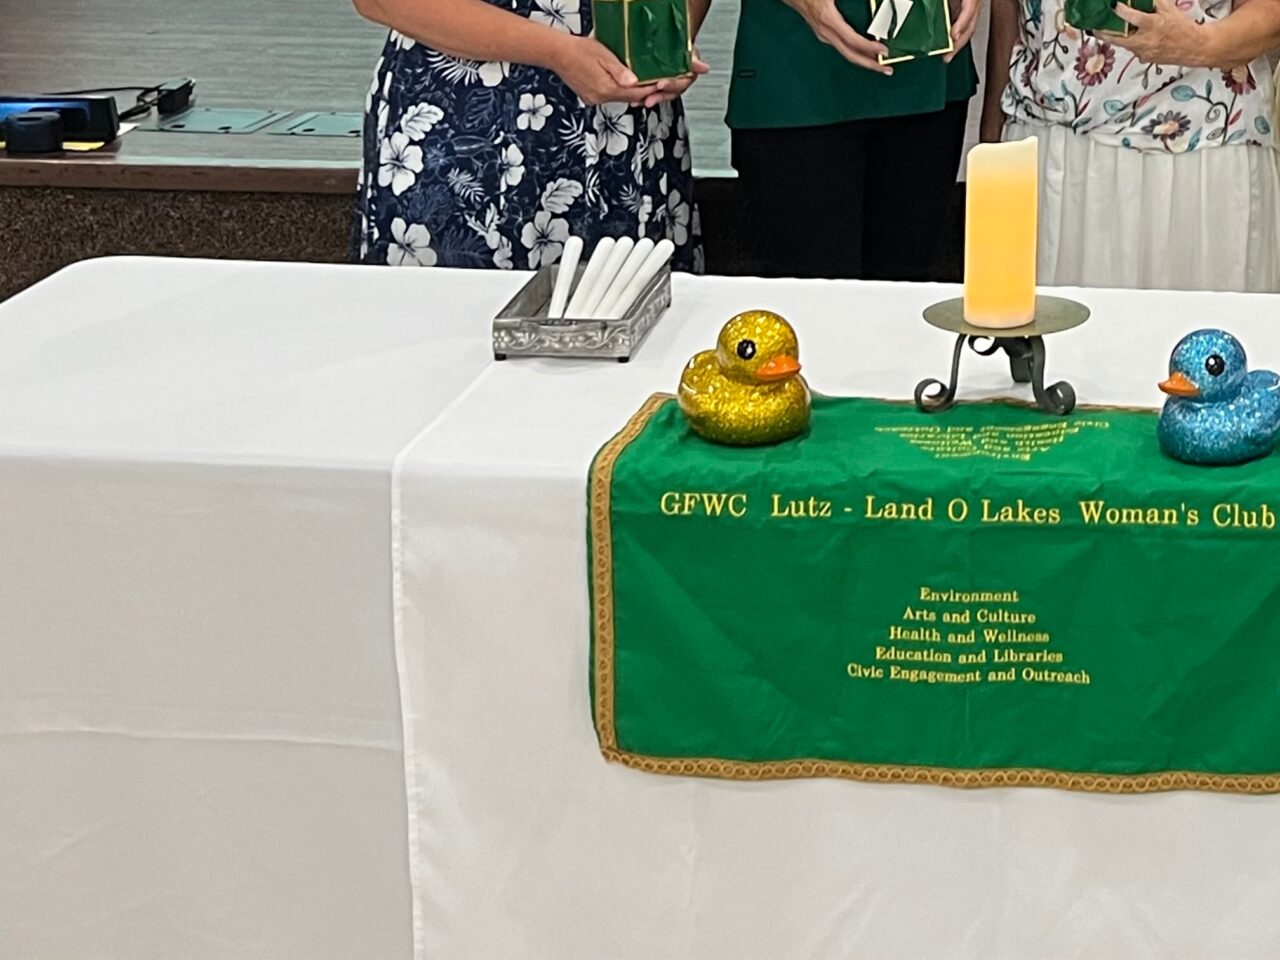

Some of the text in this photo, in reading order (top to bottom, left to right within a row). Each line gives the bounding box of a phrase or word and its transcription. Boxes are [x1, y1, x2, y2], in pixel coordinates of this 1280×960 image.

[660, 492, 747, 517] GFWC
[771, 494, 832, 518] Lutz
[865, 495, 933, 520] Land
[948, 498, 968, 522] O
[981, 499, 1061, 524] Lakes
[1079, 501, 1199, 526] Woman's
[1212, 503, 1276, 529] Club
[920, 587, 1019, 603] Environment
[903, 606, 1036, 624] Arts and Culture
[889, 625, 1050, 644] Health and Wellness
[875, 646, 1063, 664] Education and Libraries
[847, 663, 1090, 684] Civic Engagement and Outreach
